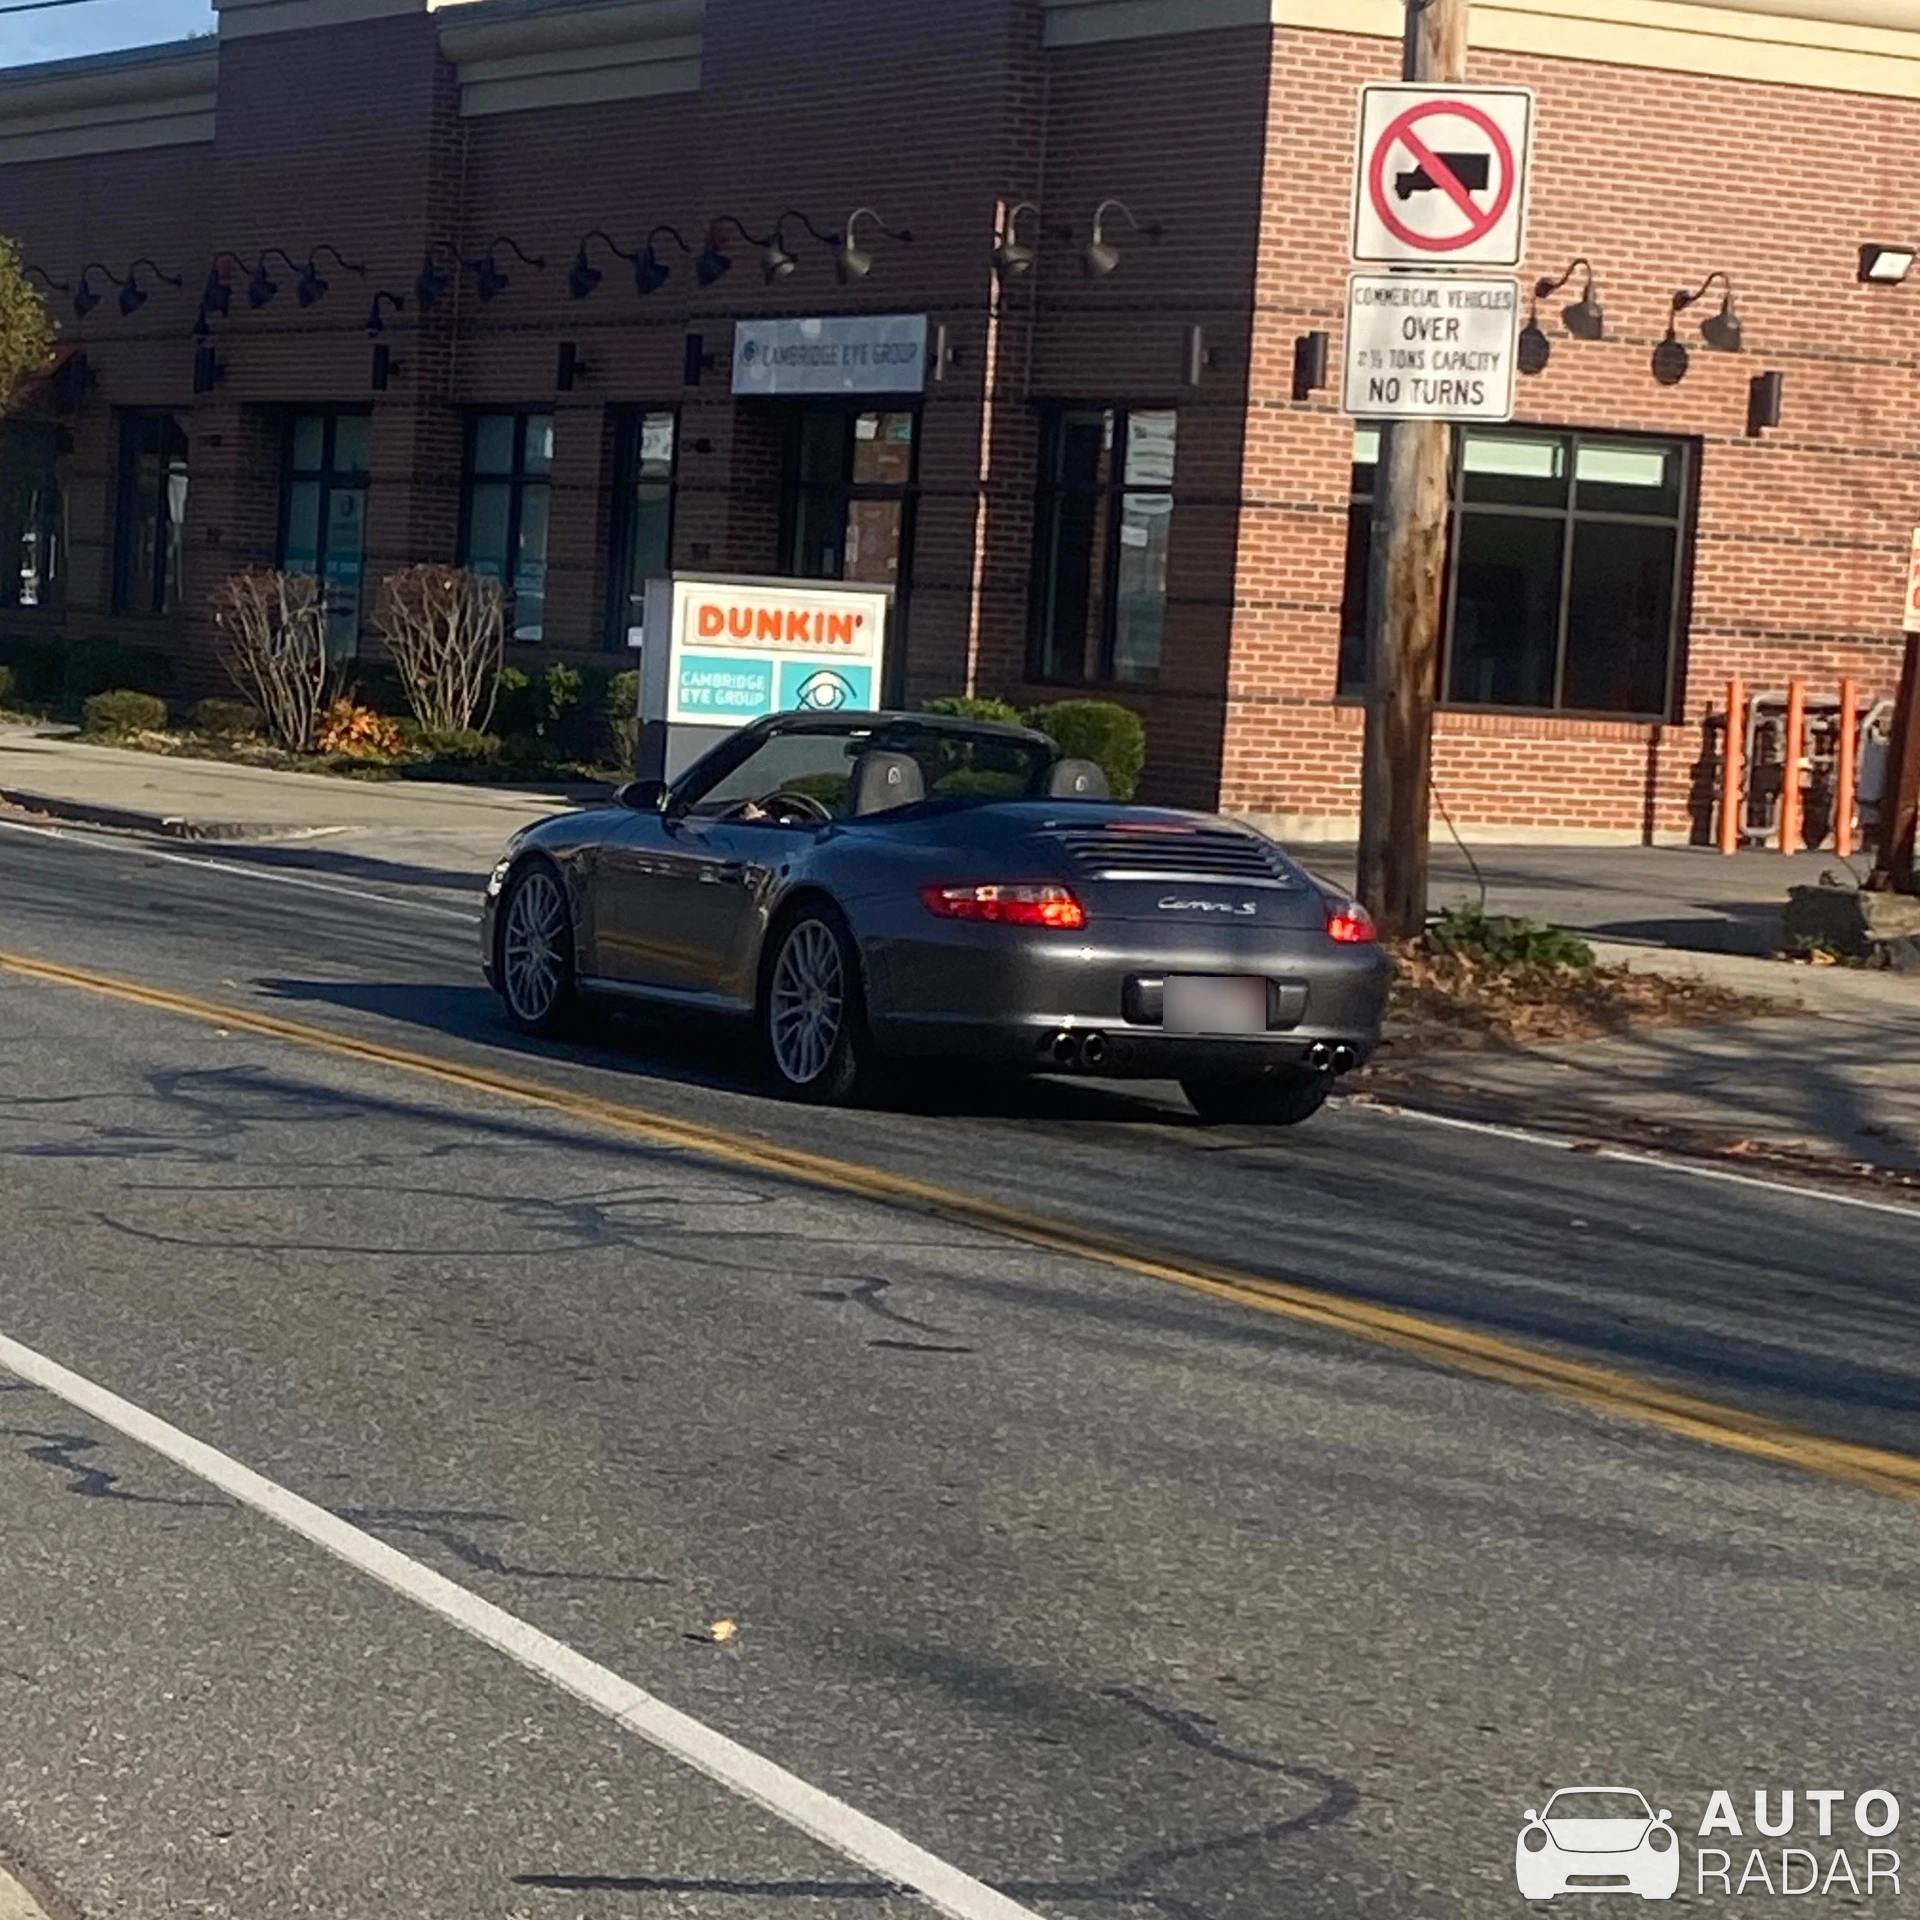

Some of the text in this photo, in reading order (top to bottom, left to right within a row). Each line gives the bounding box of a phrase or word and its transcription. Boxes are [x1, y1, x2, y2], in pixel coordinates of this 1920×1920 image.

[1354, 287, 1512, 310] COMMERCIAL VEHICLES
[1402, 315, 1460, 342] OVER
[1389, 349, 1425, 370] TONS
[1432, 350, 1501, 372] CAPACITY
[1369, 377, 1485, 406] NO TURNS
[698, 604, 863, 645] DUNKIN'
[680, 670, 766, 691] CAMBRIDGE
[680, 687, 766, 707] EYE GROUP
[1234, 901, 1257, 915] S
